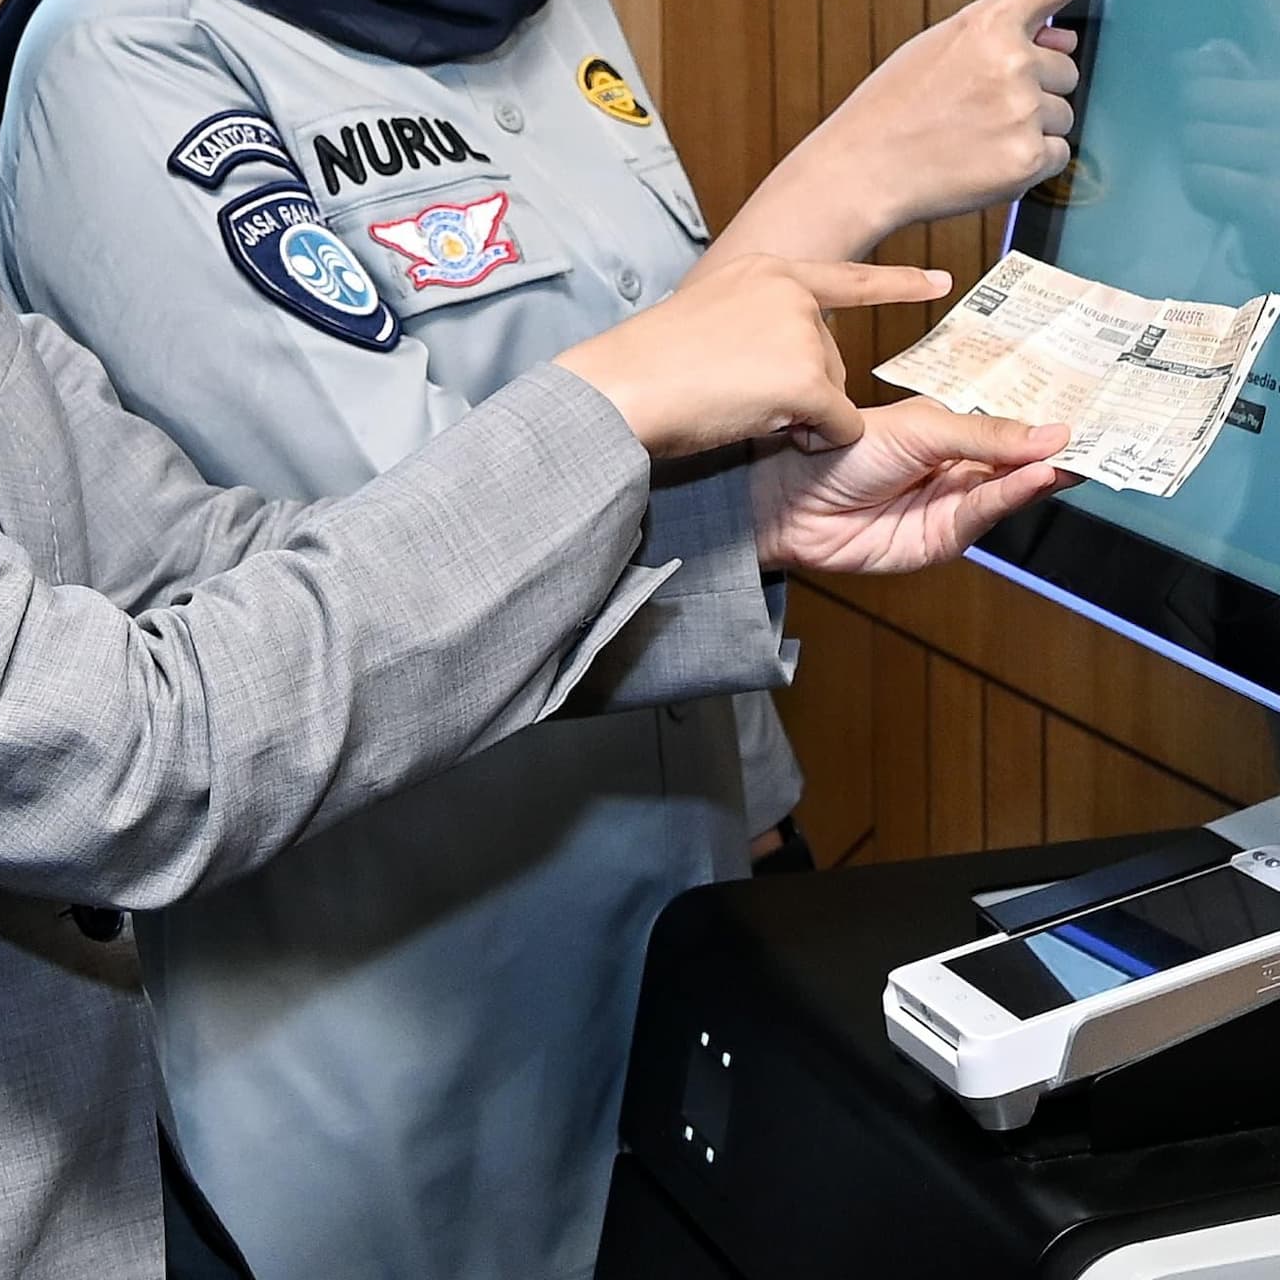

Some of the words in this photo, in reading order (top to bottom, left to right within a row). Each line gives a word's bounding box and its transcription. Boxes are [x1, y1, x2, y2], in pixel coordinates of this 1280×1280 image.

[189, 125, 258, 168] KANTOR
[313, 116, 491, 196] NURUL
[237, 209, 282, 246] JASA
